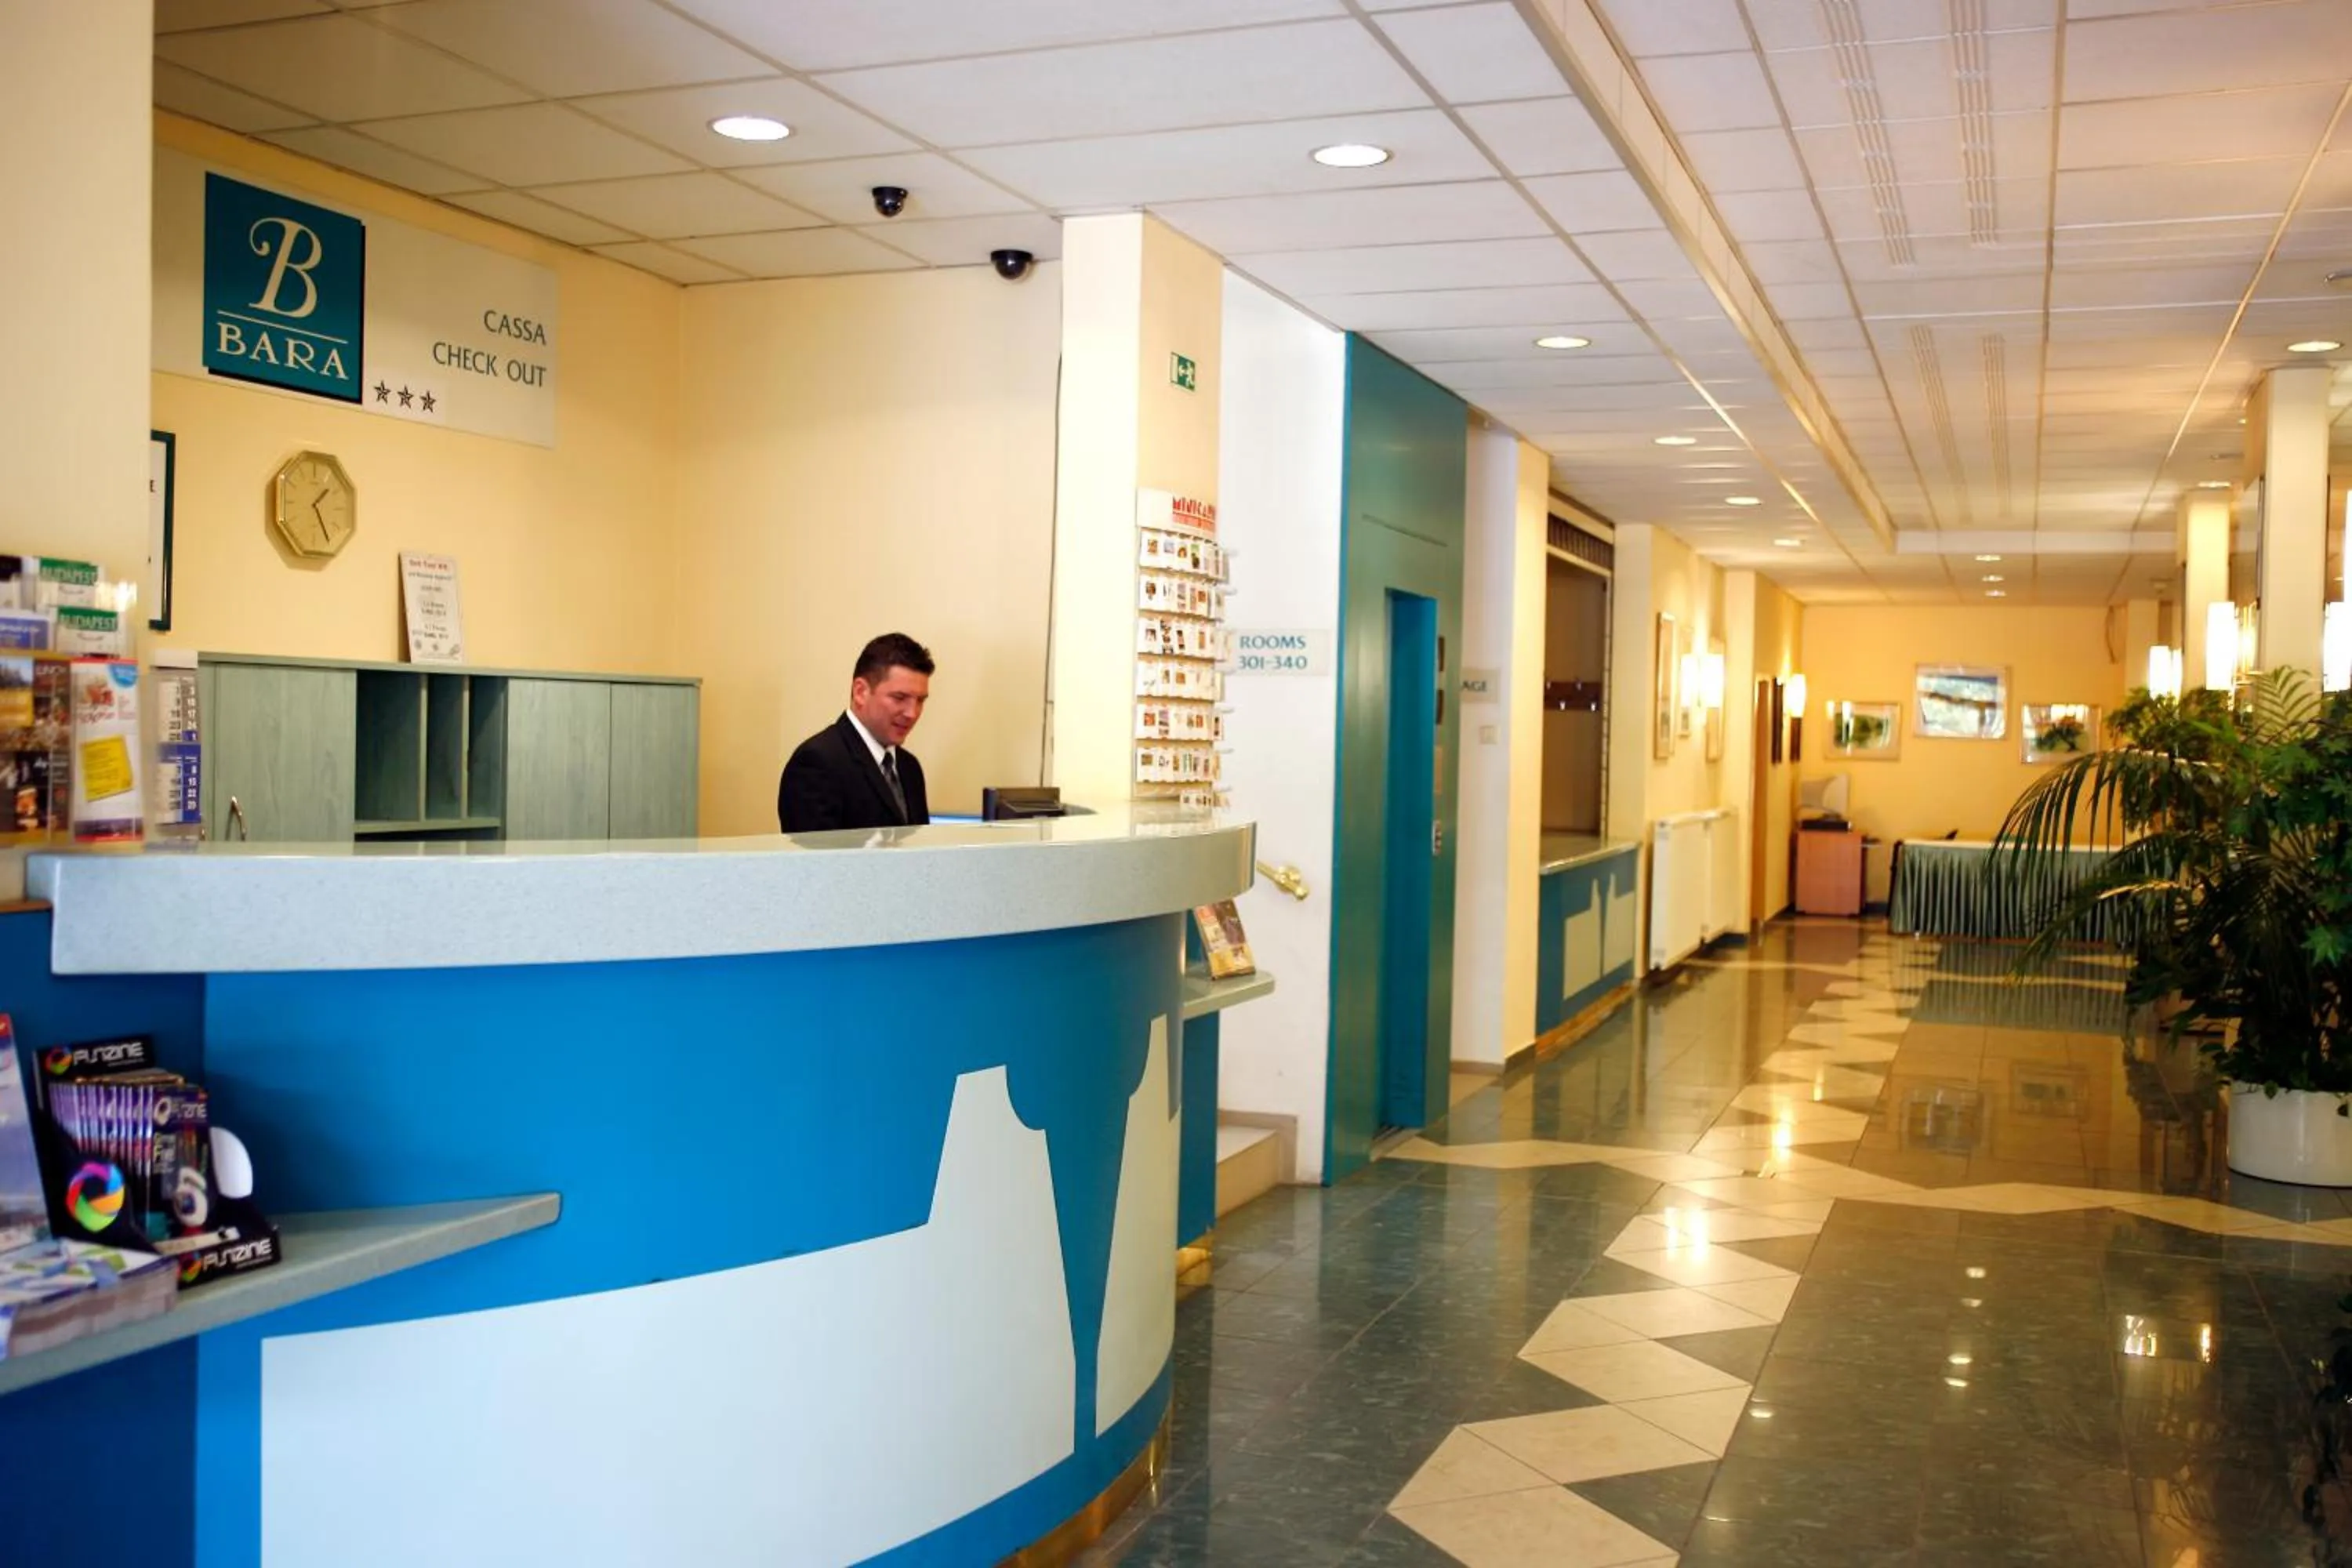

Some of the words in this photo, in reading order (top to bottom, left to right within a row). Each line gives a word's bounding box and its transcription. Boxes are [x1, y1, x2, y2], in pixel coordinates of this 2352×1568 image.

[484, 310, 546, 346] CASSA
[216, 322, 350, 381] BARA
[433, 342, 498, 377] CHECK
[507, 358, 546, 387] OUT
[1240, 635, 1306, 649] ROOMS
[1239, 655, 1307, 670] 301-340
